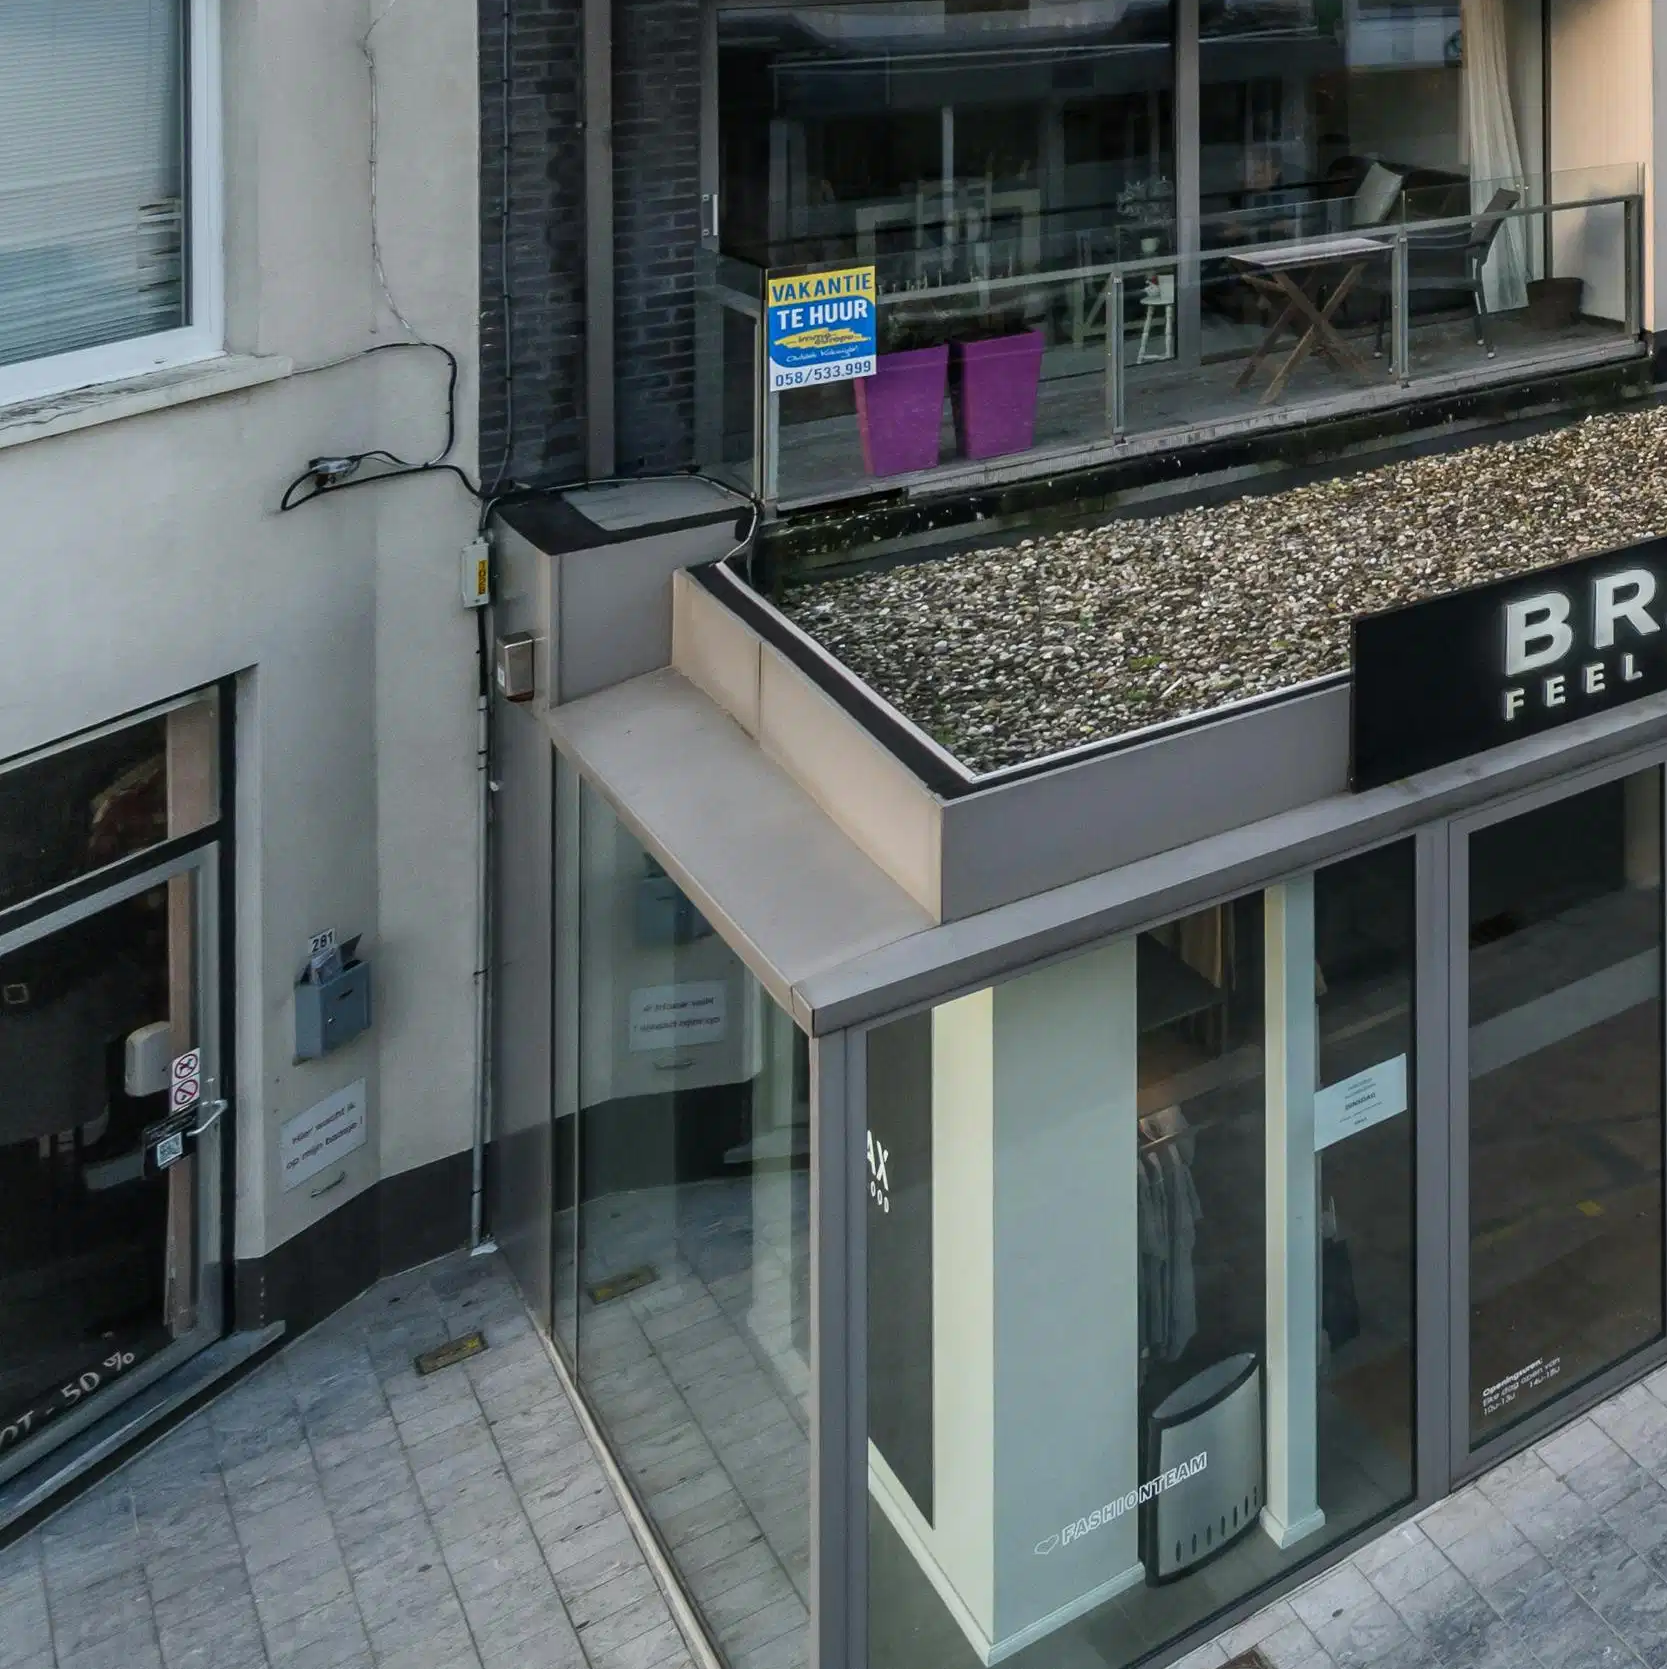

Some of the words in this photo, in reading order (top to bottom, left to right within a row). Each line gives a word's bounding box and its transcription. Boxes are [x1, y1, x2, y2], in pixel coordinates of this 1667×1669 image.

[772, 272, 873, 302] VAKANTIE
[777, 308, 805, 330] TE
[809, 299, 868, 325] HUUR
[775, 360, 872, 387] 058/533.999
[1504, 652, 1644, 722] FEEL
[311, 931, 334, 953] 281
[61, 1371, 100, 1407] 50
[1061, 1451, 1208, 1547] FASHIONTEAM
